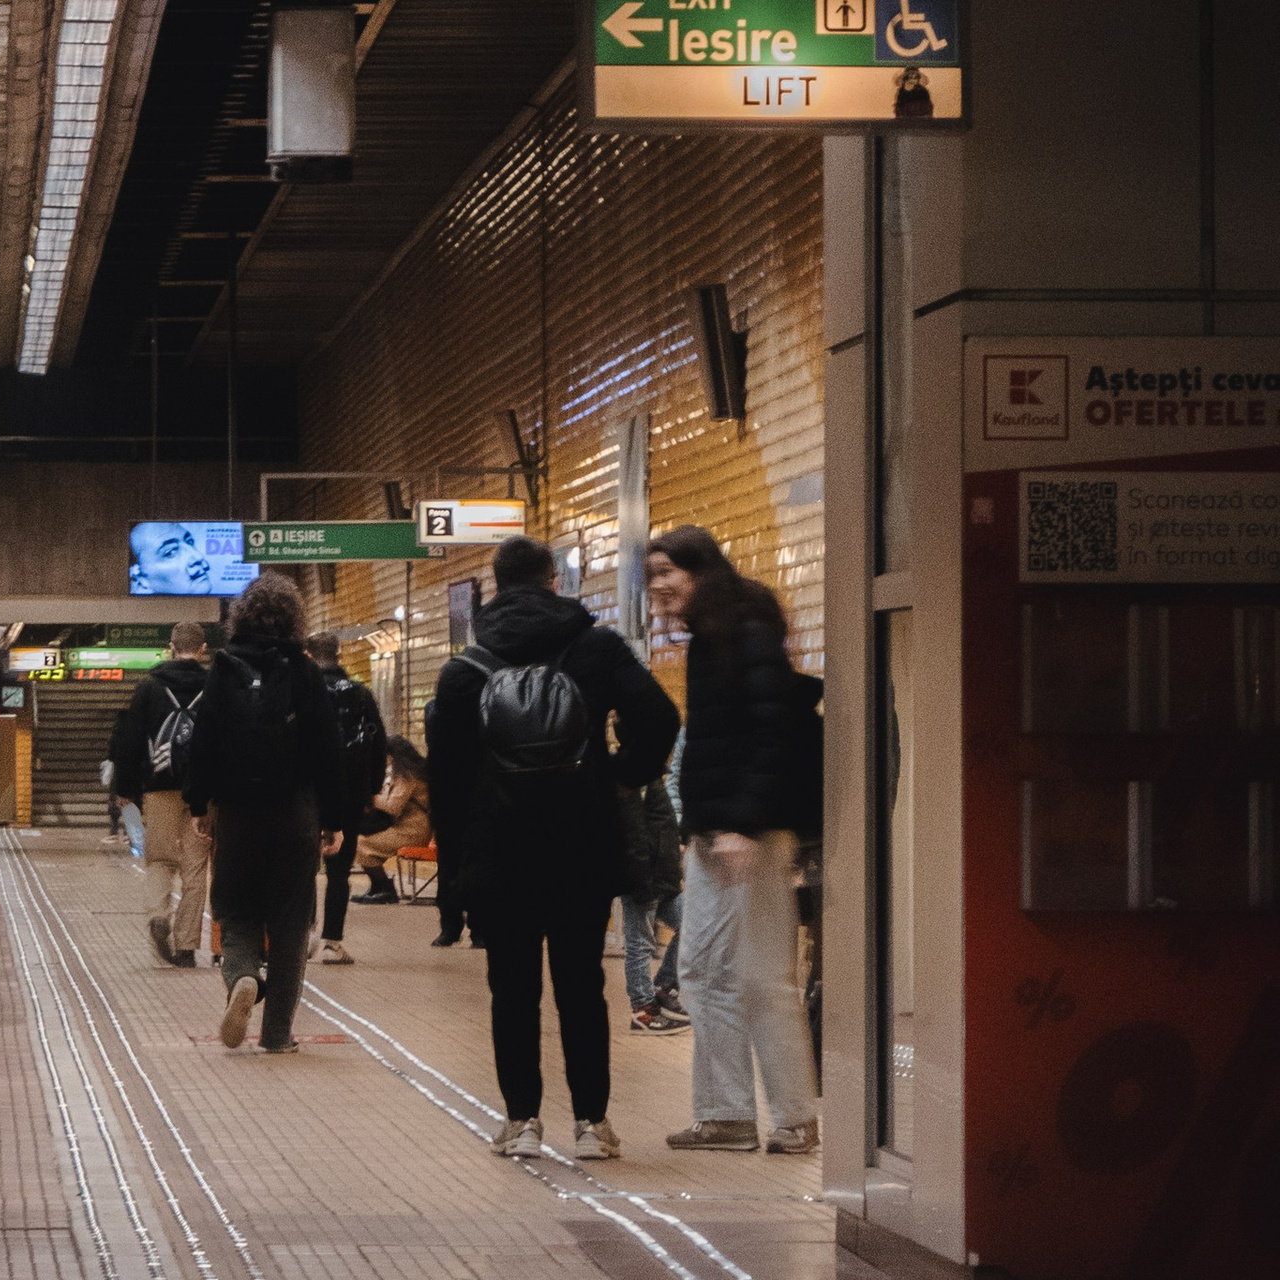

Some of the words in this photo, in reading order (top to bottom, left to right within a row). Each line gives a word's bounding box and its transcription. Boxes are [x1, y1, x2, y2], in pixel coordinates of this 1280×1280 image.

[668, 18, 797, 62] Iesire
[742, 76, 817, 106] LIFT
[1084, 365, 1204, 398] Aștepți
[992, 412, 1058, 428] Kaufland
[1085, 399, 1267, 427] OFERTELE
[432, 517, 447, 535] 2
[1156, 544, 1238, 565] format
[46, 656, 56, 666] 2
